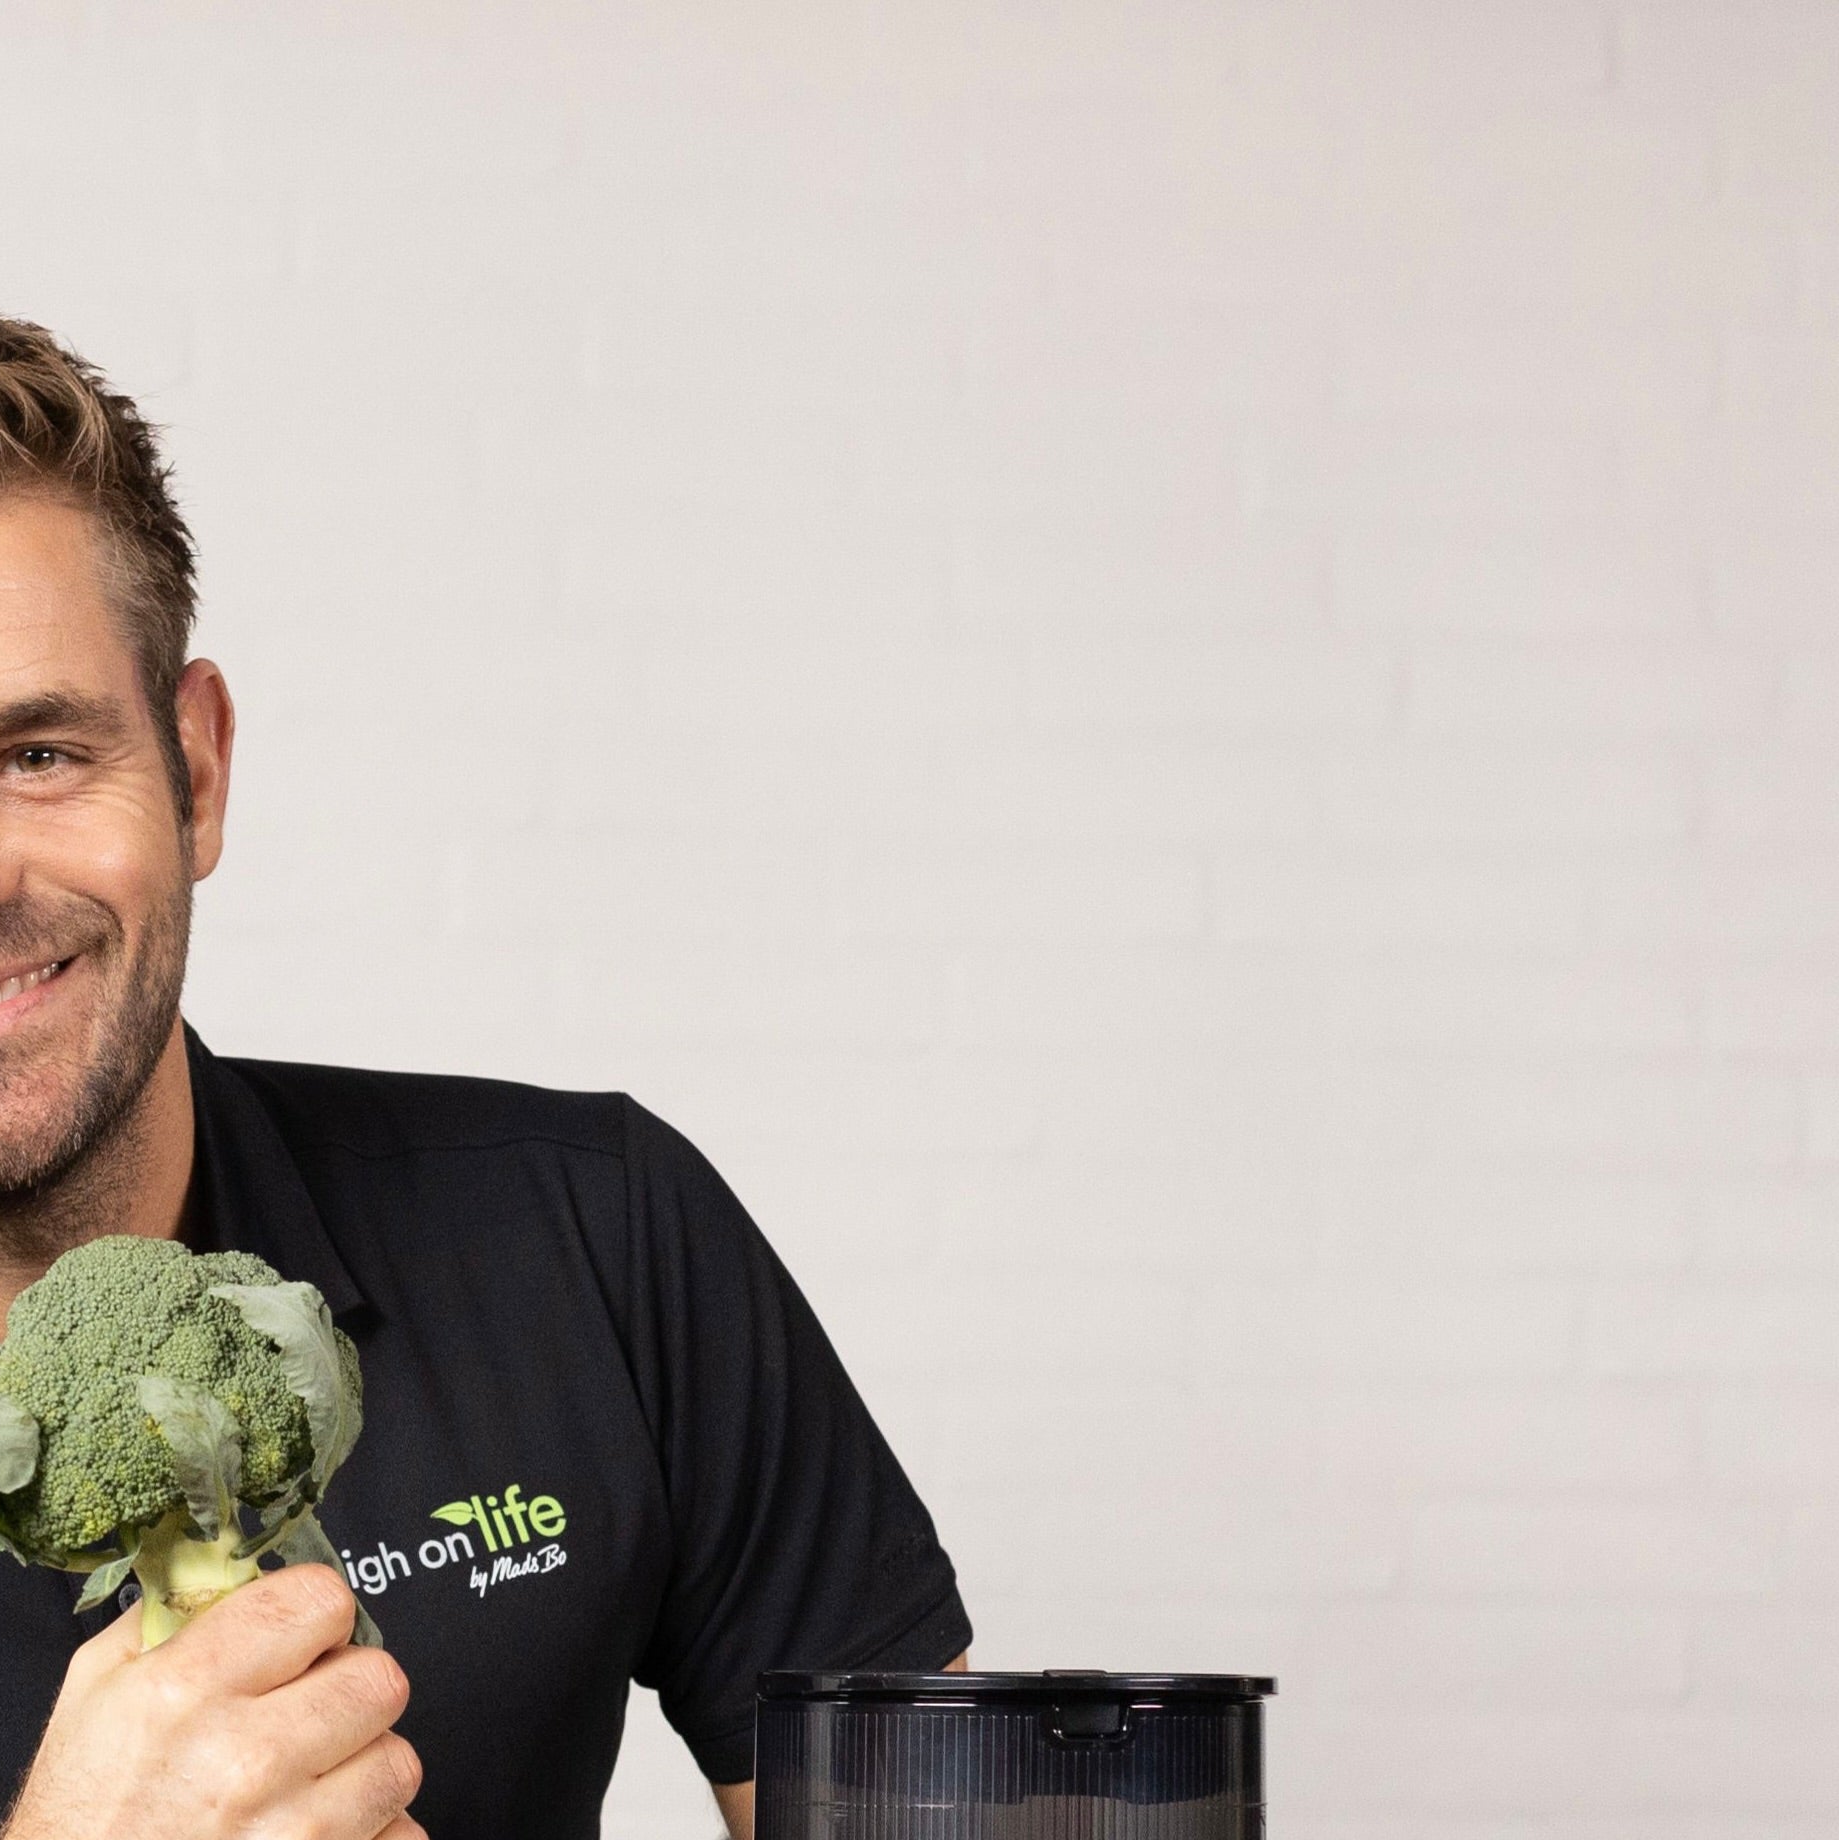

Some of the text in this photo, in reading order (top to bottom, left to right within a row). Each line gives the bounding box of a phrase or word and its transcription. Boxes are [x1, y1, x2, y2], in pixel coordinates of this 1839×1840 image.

[340, 1484, 567, 1596] igh on life
[469, 1542, 567, 1598] by Mads Bo
